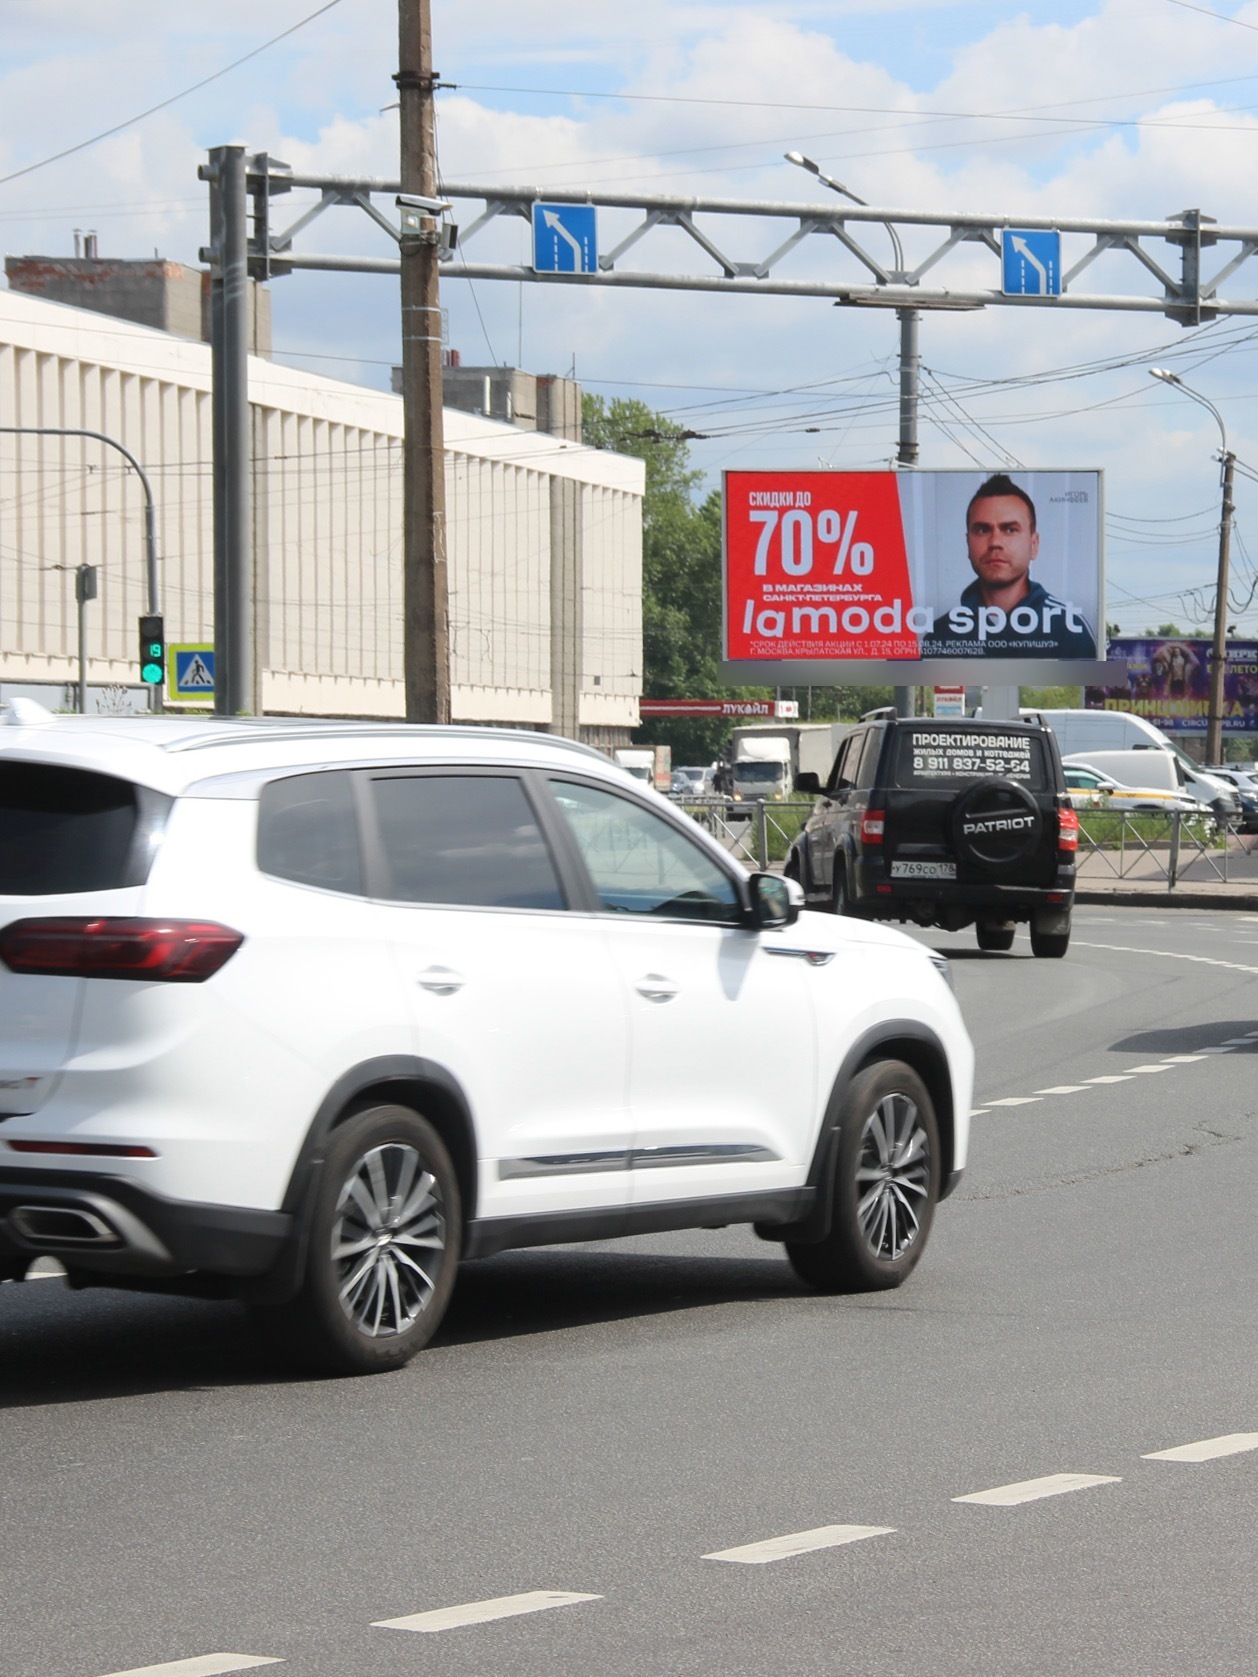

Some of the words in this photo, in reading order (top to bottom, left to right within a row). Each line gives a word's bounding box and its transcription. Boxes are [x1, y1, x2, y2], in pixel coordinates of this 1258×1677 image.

[749, 491, 794, 507] СКИДКИ
[795, 491, 812, 507] ДО
[749, 509, 874, 576] 70%
[763, 584, 773, 592] В
[775, 584, 863, 592] МАГАЗИНАХ
[763, 594, 883, 602] САНКТ-ПЕТЕРБУРГА
[743, 599, 934, 637] lamoda
[948, 601, 1083, 640] sport
[946, 640, 986, 648] РЕКЛАМА
[988, 640, 1007, 648] ООО
[1230, 664, 1258, 674] ЛЕТО
[723, 702, 768, 714] ЛУКОЙЛ
[912, 733, 1031, 750] ПРОЕКТИРОВАНИЕ
[913, 757, 923, 769] 8
[928, 757, 948, 769] 911
[963, 816, 1034, 835] PATRIOT
